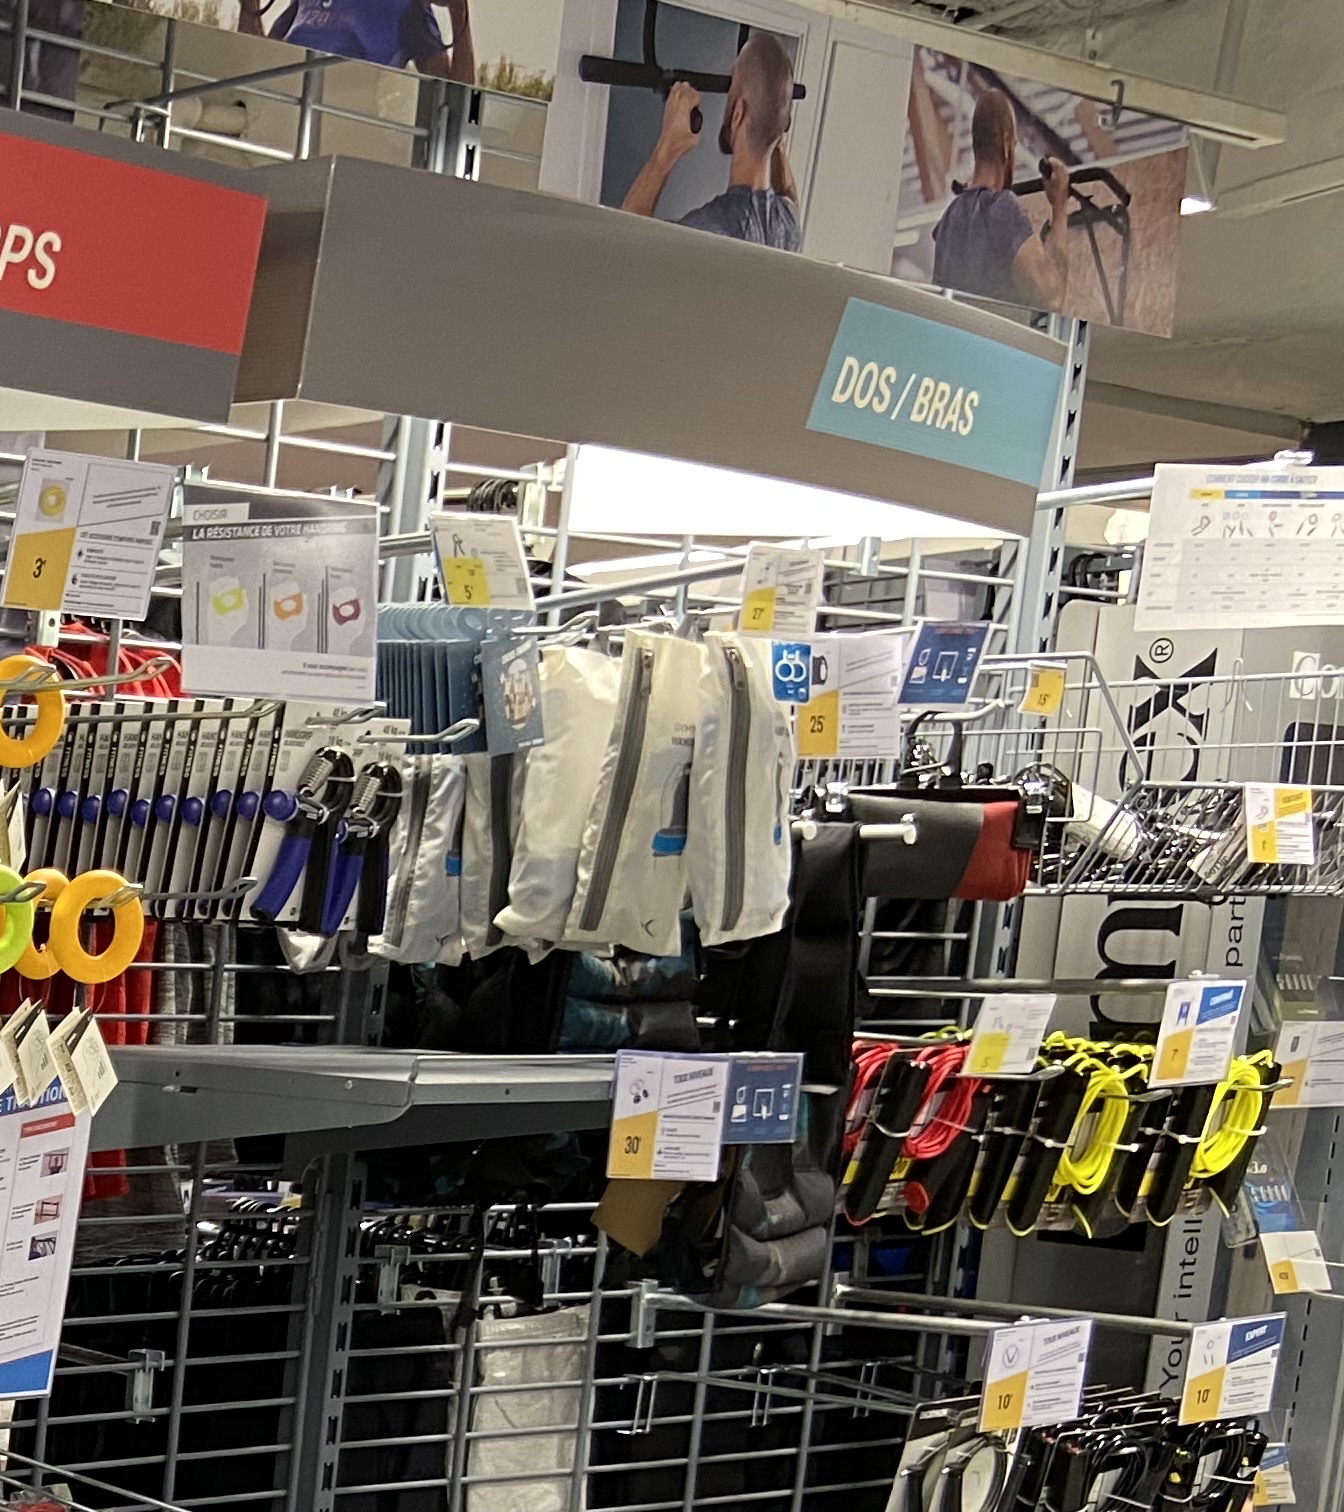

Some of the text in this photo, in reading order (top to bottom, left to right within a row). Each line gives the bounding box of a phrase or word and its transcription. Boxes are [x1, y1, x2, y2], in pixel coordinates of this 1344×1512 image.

[832, 356, 979, 437] DOS / BRAS
[192, 508, 228, 521] CHOISIR
[192, 523, 302, 540] LA RÉSISTANCE DE VOTRE
